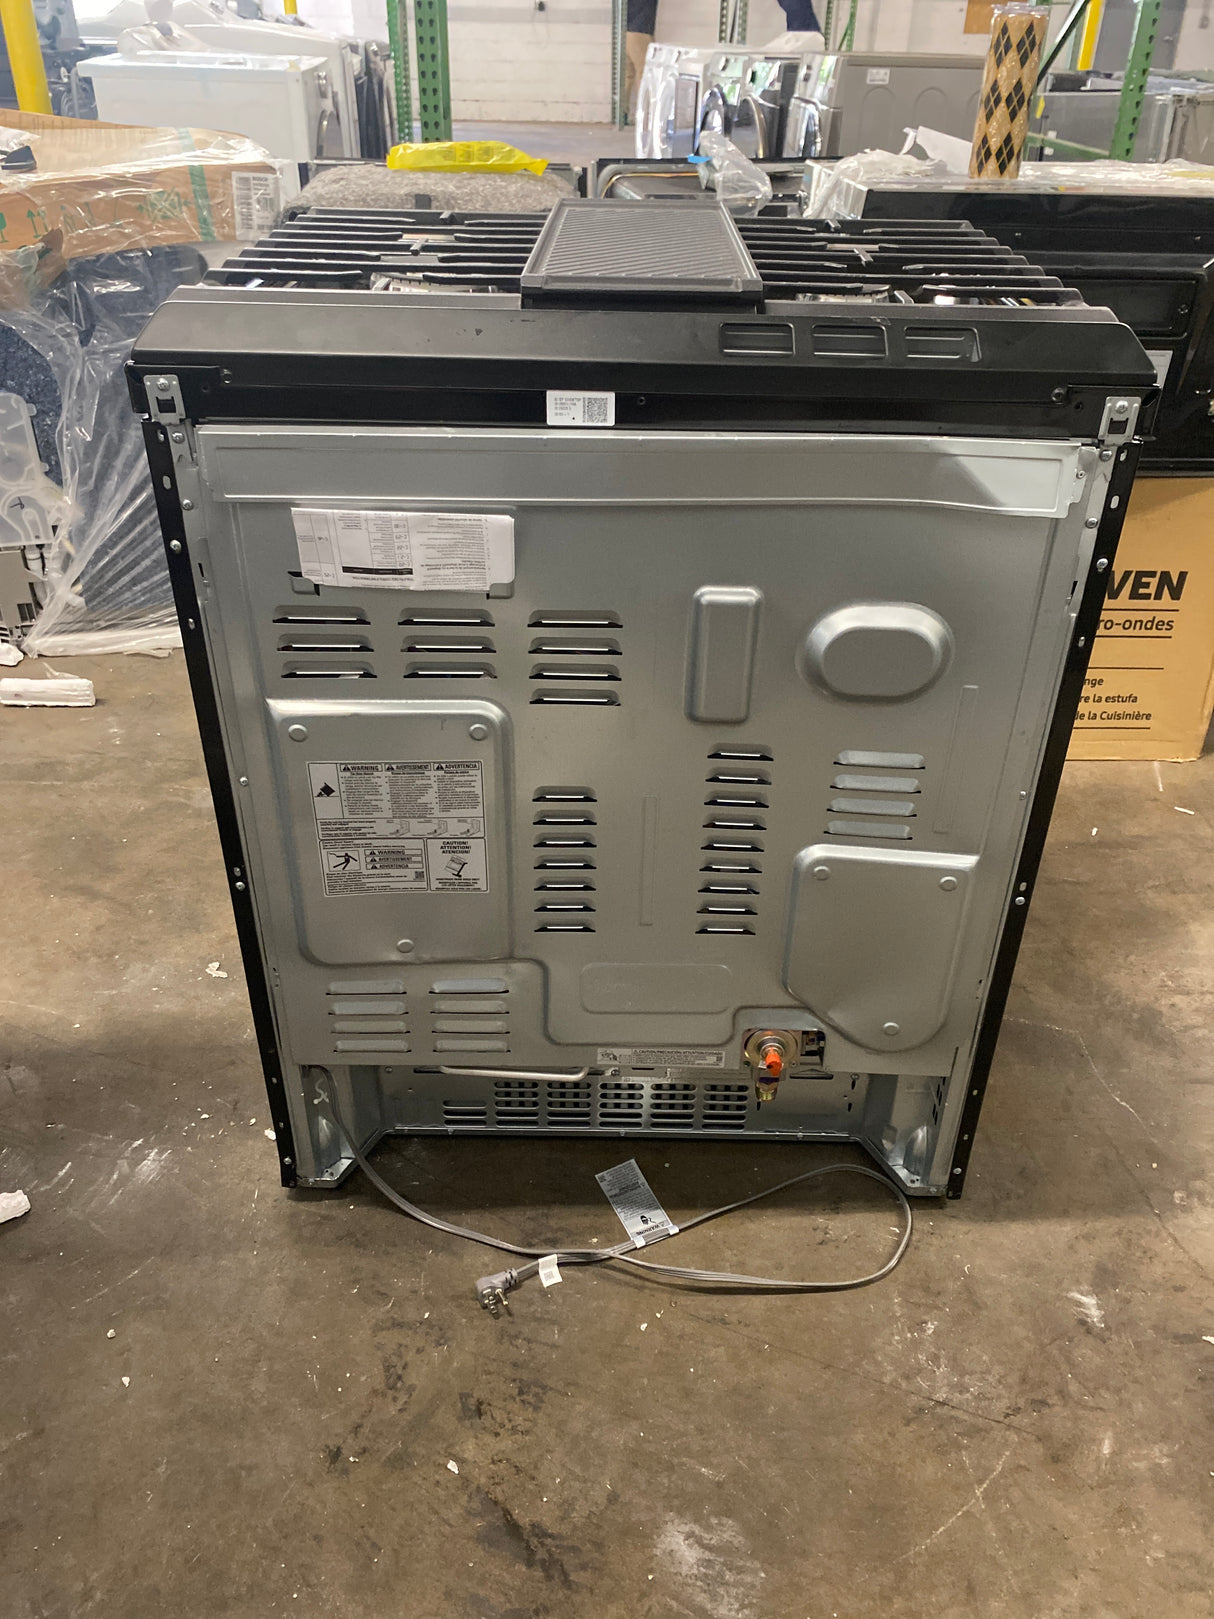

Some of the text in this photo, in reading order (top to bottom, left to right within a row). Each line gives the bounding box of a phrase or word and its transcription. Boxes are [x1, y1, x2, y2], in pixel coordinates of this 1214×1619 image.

[1092, 693, 1103, 703] la
[1105, 693, 1138, 703] estufa
[1087, 710, 1097, 720] la
[1100, 710, 1152, 720] Cuisinière
